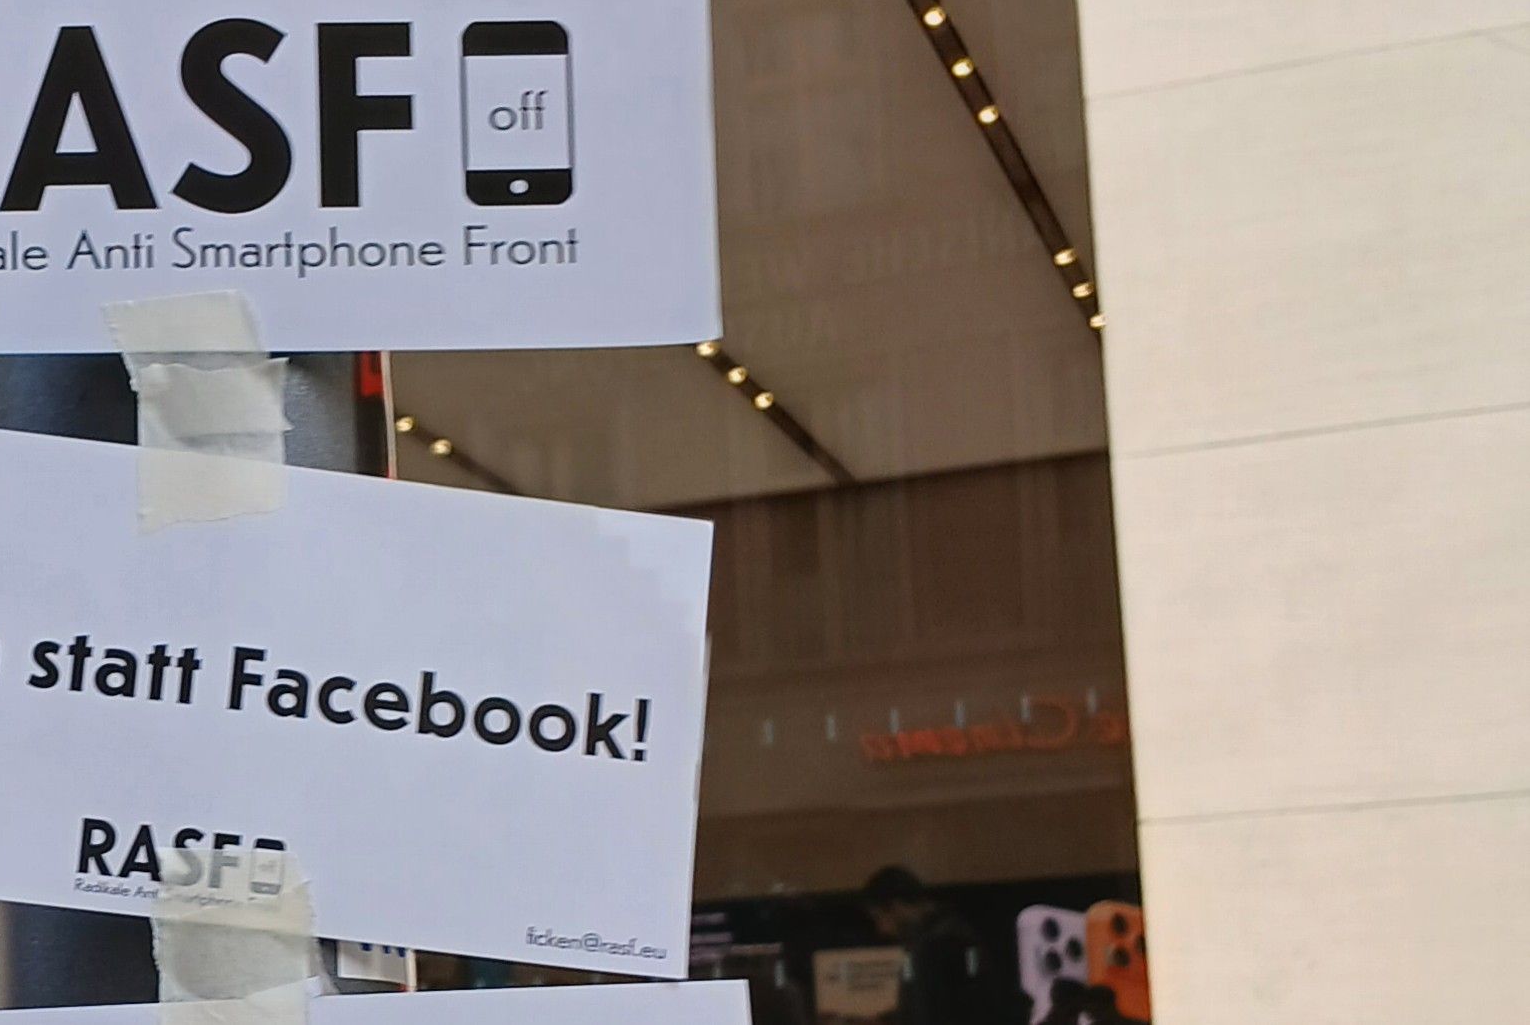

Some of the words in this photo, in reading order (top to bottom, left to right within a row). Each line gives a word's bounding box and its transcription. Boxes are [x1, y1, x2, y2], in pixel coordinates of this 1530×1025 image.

[488, 90, 548, 131] off
[67, 229, 155, 270] Anti
[171, 226, 446, 279] Smartphone
[463, 224, 579, 266] Front
[28, 635, 201, 705] statt
[228, 646, 650, 762] Facebook!
[76, 817, 244, 890] RASF
[525, 925, 669, 960] ficken@rasf.eu
